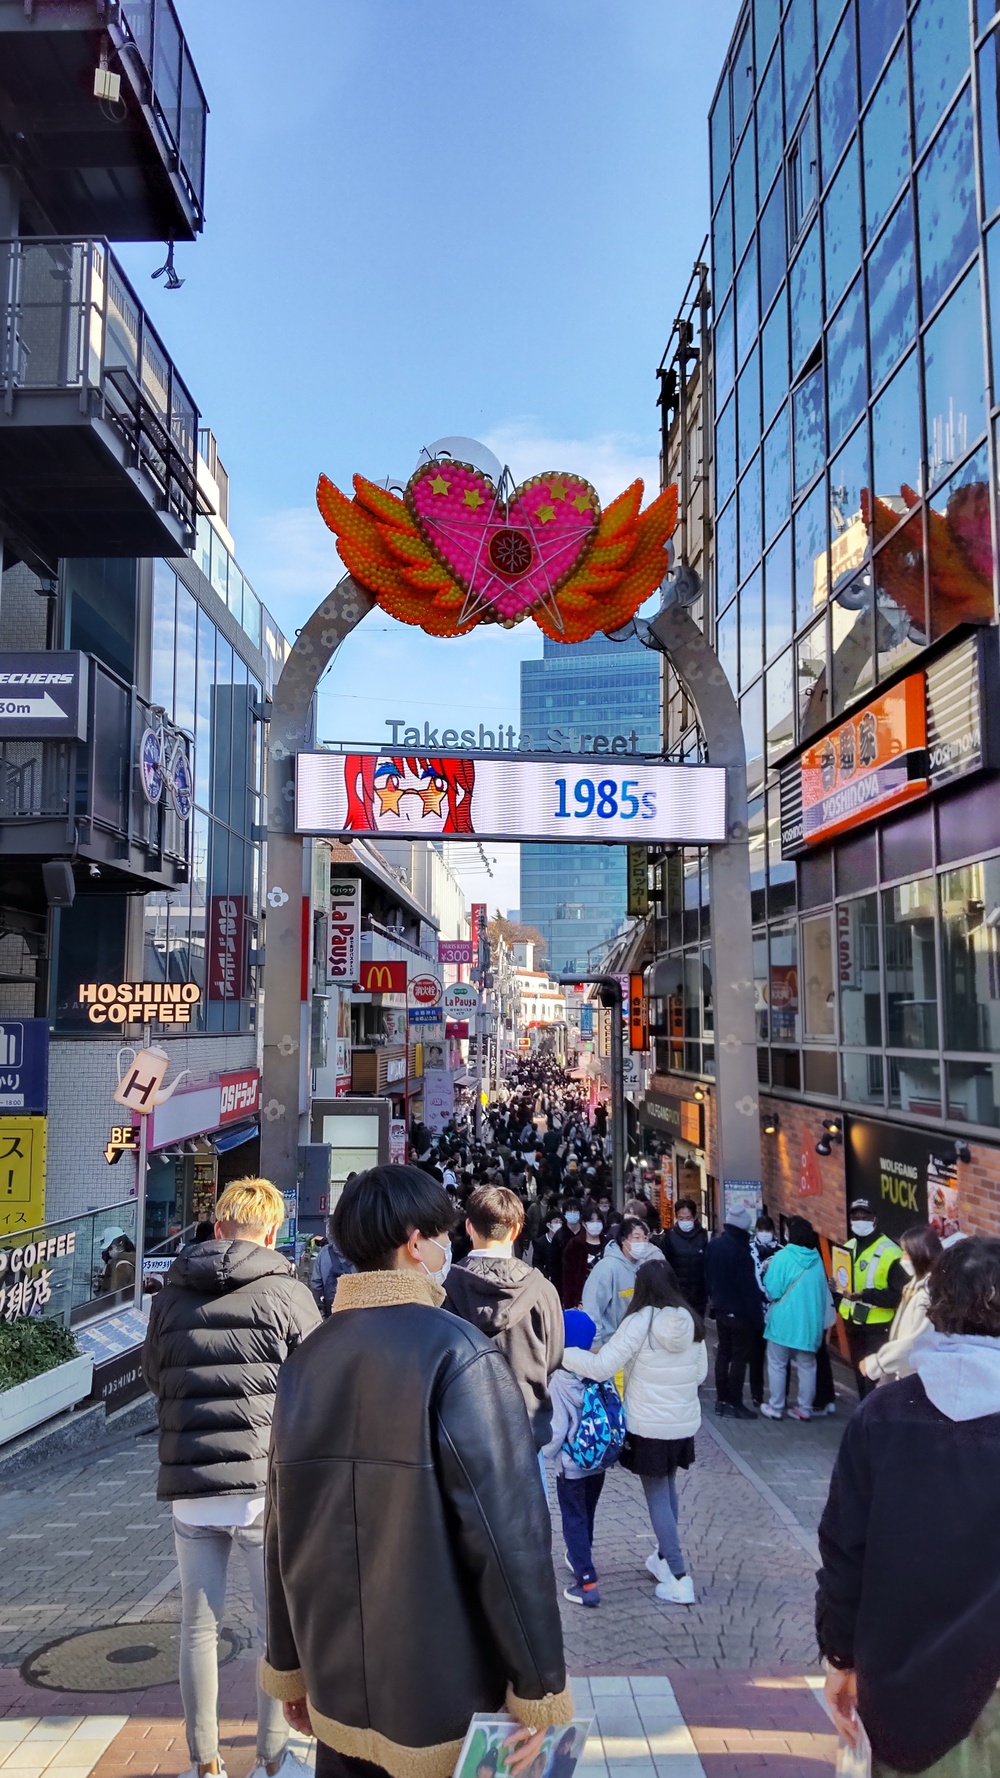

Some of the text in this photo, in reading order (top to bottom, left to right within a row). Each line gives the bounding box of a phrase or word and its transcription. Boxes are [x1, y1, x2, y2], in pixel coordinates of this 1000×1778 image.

[385, 719, 641, 755] Takeshita Street
[822, 774, 880, 820] YOSHINOYA
[328, 901, 355, 976] La Pausa
[441, 950, 470, 962] ¥300
[79, 983, 201, 1003] HOSHINO
[415, 985, 436, 996] 消火栓
[445, 996, 477, 1007] La Pausa
[88, 1003, 191, 1024] COFFEE
[123, 1069, 158, 1105] H
[220, 1079, 258, 1113] OSドラッグ
[111, 1127, 132, 1143] BF
[880, 1157, 918, 1180] WOLFGANG
[880, 1174, 919, 1213] PUCK
[11, 1231, 76, 1273] COFFEE
[102, 1369, 136, 1398] HOSHINO
